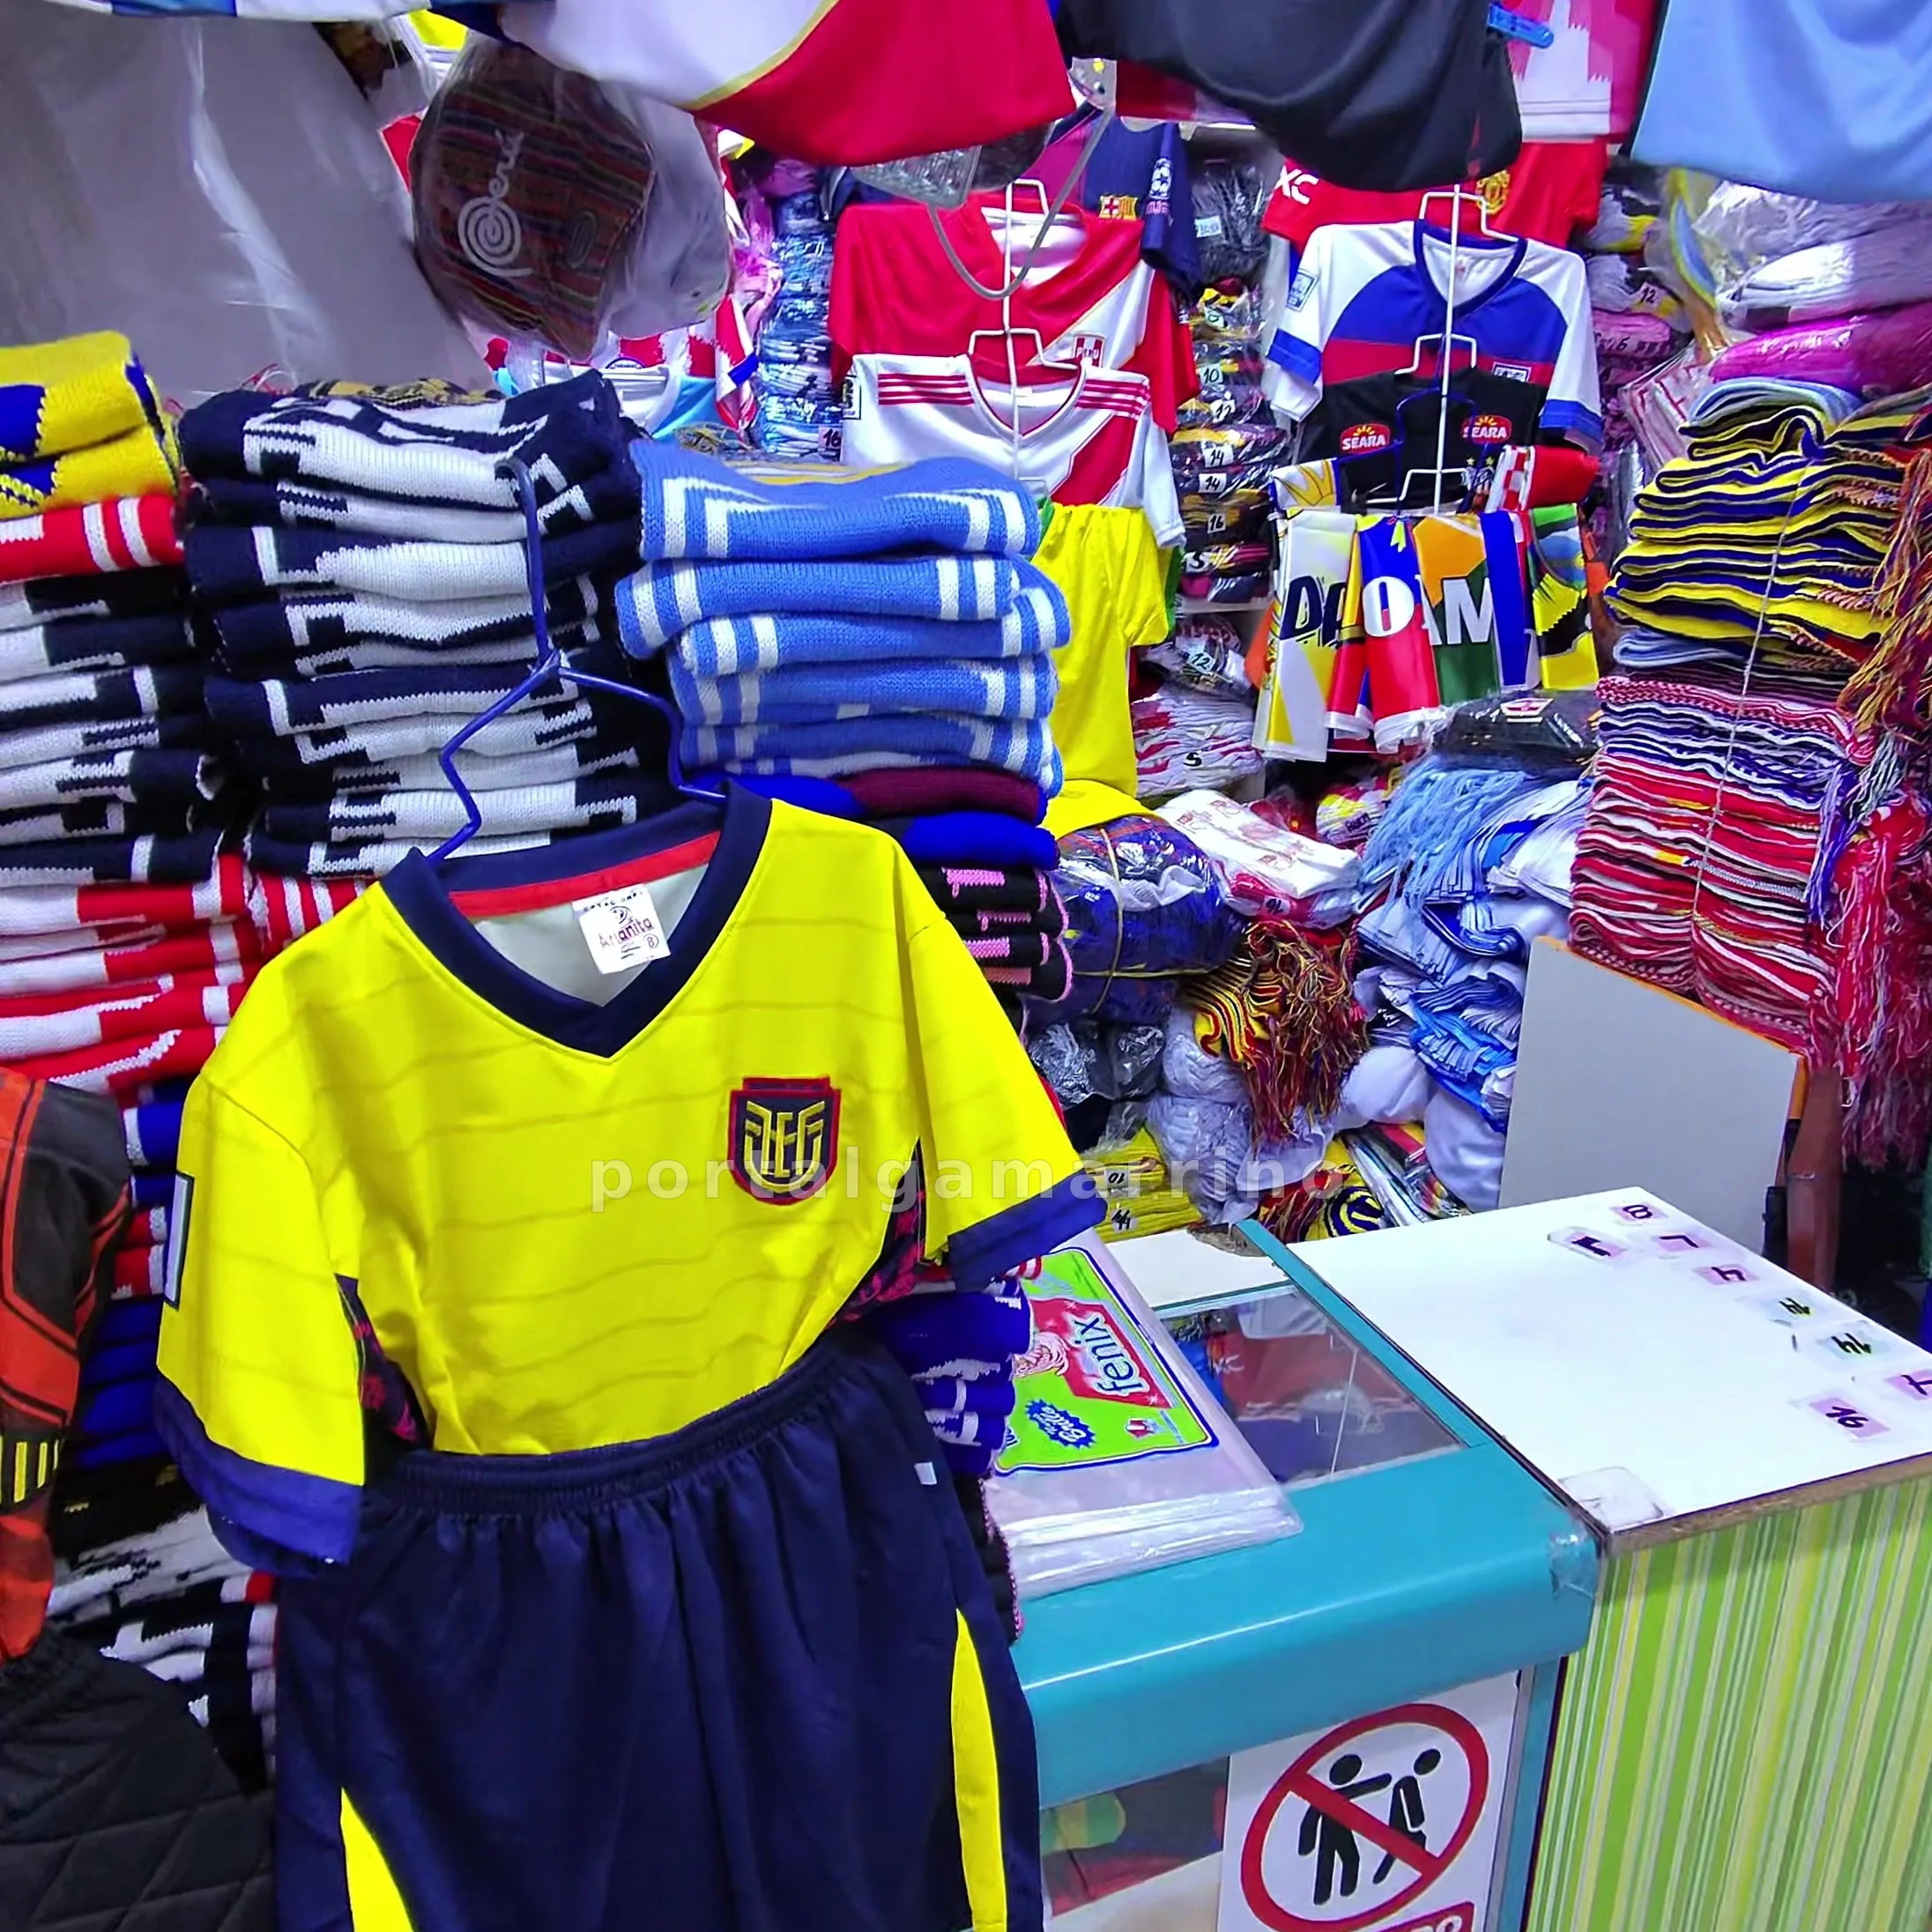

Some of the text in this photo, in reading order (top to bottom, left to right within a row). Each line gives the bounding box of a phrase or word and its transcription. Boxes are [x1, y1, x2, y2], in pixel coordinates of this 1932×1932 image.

[1203, 368, 1219, 383] 10
[1341, 435, 1386, 450] SEARA
[1210, 449, 1224, 465] 14
[1206, 476, 1220, 490] 14
[1209, 515, 1223, 530] 16
[1192, 653, 1210, 670] 12
[1184, 752, 1202, 767] S
[1073, 1317, 1143, 1393] fenix
[1826, 1406, 1869, 1429] 16
